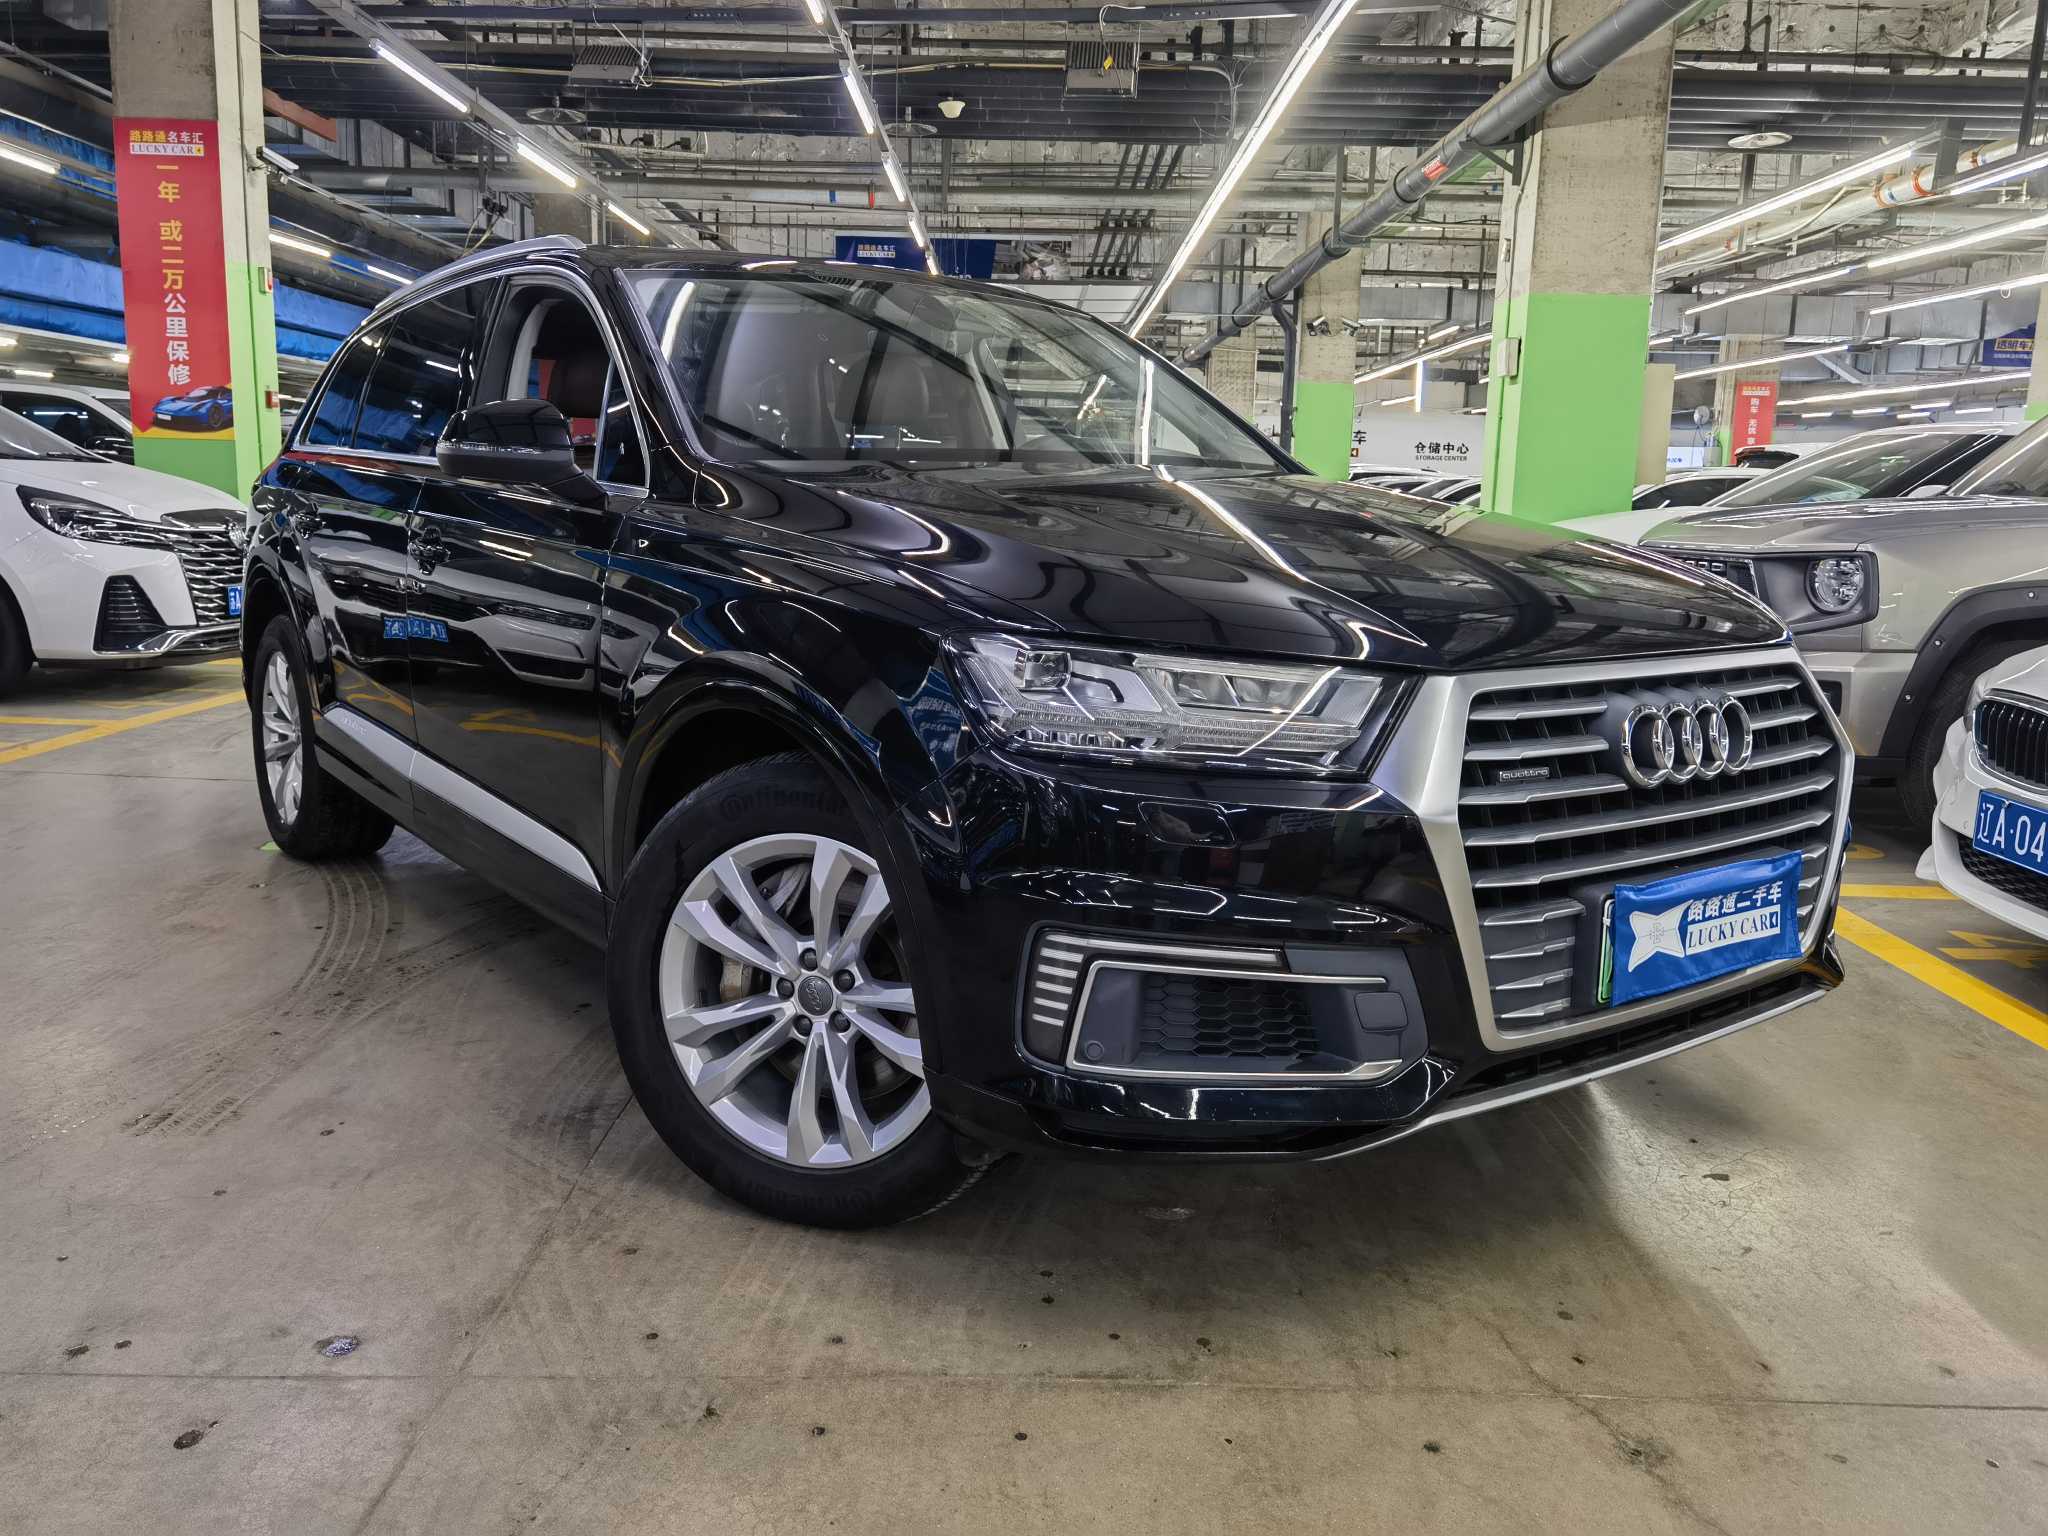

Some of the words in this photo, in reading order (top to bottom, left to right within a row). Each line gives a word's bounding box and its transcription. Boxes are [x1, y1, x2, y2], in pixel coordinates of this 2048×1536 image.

[129, 130, 204, 143] 路路通名车汇
[131, 145, 169, 153] LUCKY
[171, 145, 194, 154] CAR
[1414, 441, 1470, 455] 仓储中心
[1687, 881, 1784, 922] 路路通二手车
[1687, 918, 1739, 948] LUCKY
[1739, 913, 1771, 938] CAR
